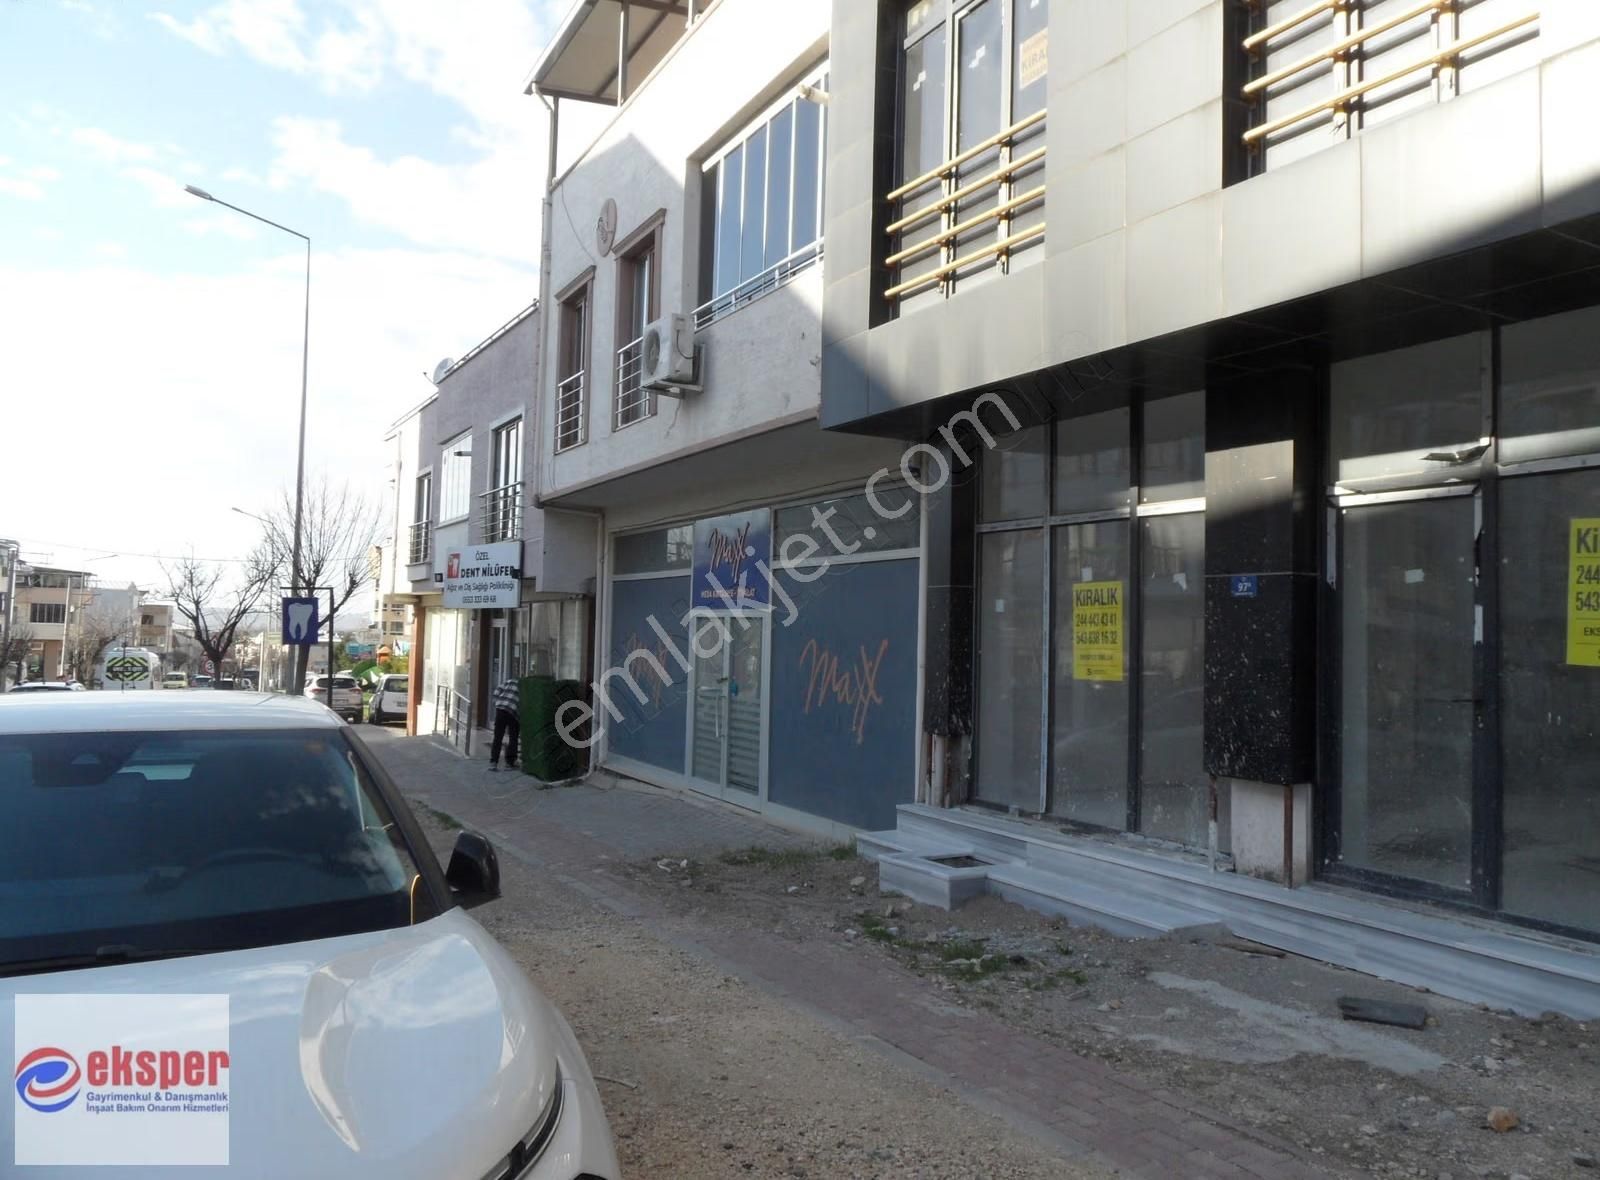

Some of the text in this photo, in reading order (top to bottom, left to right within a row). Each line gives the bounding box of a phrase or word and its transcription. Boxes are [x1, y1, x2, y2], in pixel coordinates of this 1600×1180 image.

[476, 551, 489, 561] ÖZEL
[461, 567, 481, 578] DENT
[1576, 564, 1600, 585] 244
[1576, 591, 1600, 612] 543
